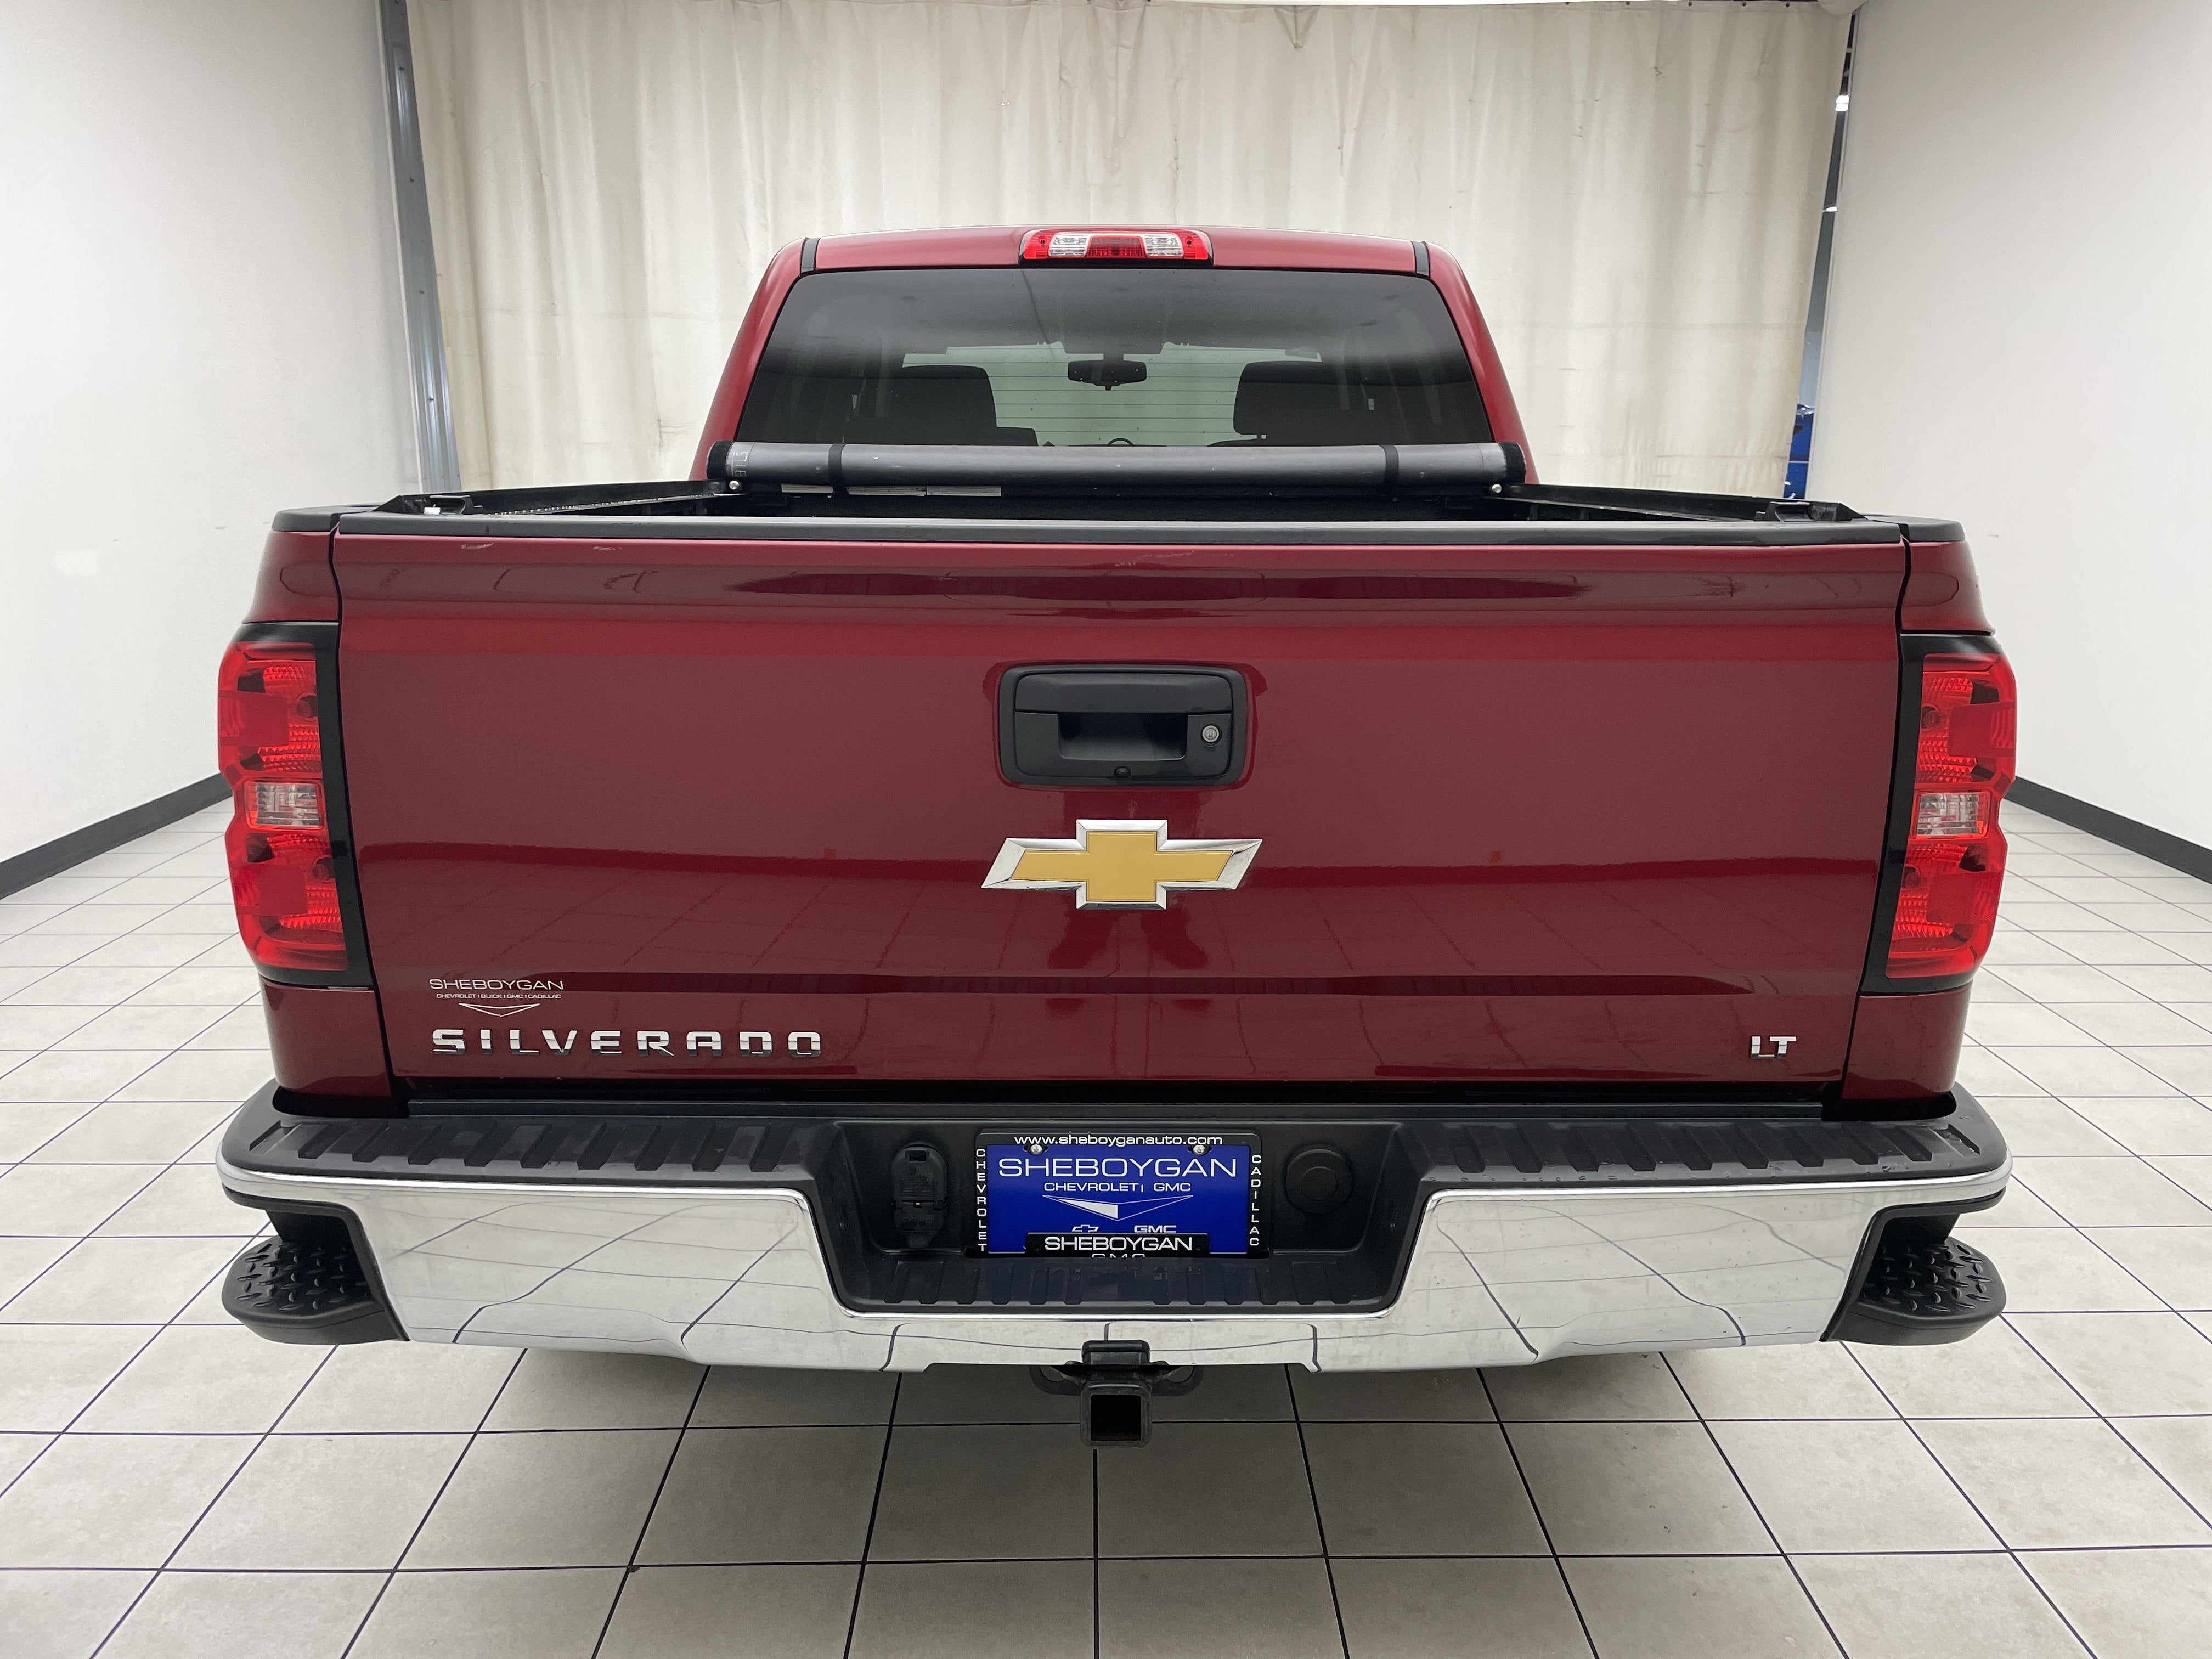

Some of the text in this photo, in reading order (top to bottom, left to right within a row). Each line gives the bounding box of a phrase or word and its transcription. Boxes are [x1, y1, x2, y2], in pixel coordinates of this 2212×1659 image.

[430, 979, 563, 990] SHEBOYGAN
[432, 1029, 821, 1057] SILVERADO
[1750, 1036, 1797, 1059] LT
[1014, 1135, 1223, 1147] www.sheboyganauto.com
[999, 1159, 1235, 1177] SHEBOYGAN
[1154, 1183, 1190, 1191] GMC
[977, 1149, 986, 1251] CHEVROLET
[1250, 1155, 1261, 1245] CADILLAC
[1045, 1237, 1192, 1250] SHEBOYGAN
